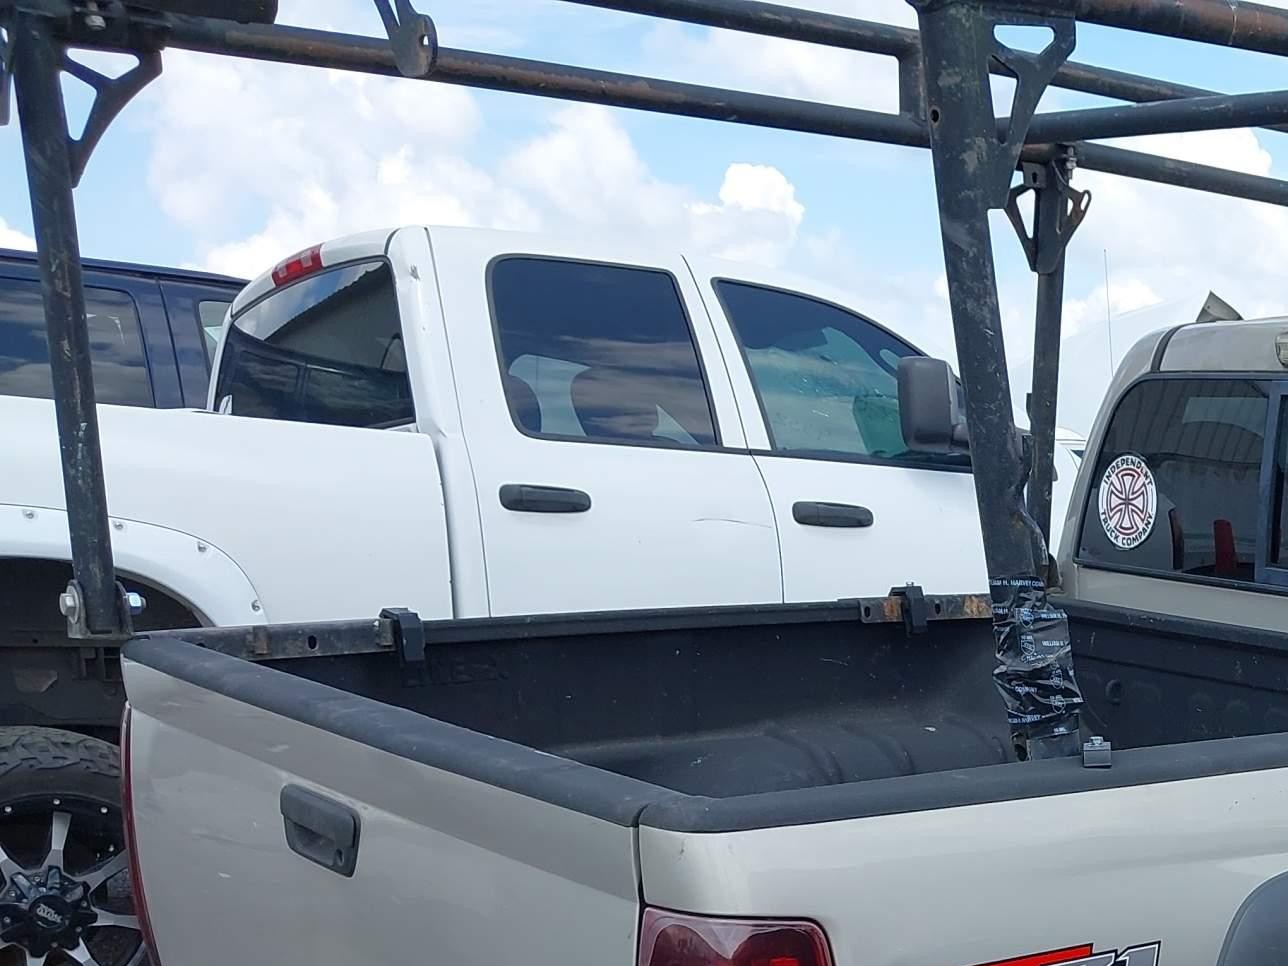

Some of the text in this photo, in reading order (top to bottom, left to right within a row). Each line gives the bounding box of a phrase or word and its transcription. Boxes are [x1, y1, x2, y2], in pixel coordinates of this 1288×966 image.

[1103, 457, 1153, 486] INDEPENDENT
[1101, 509, 1153, 546] TRUCK COMPANY
